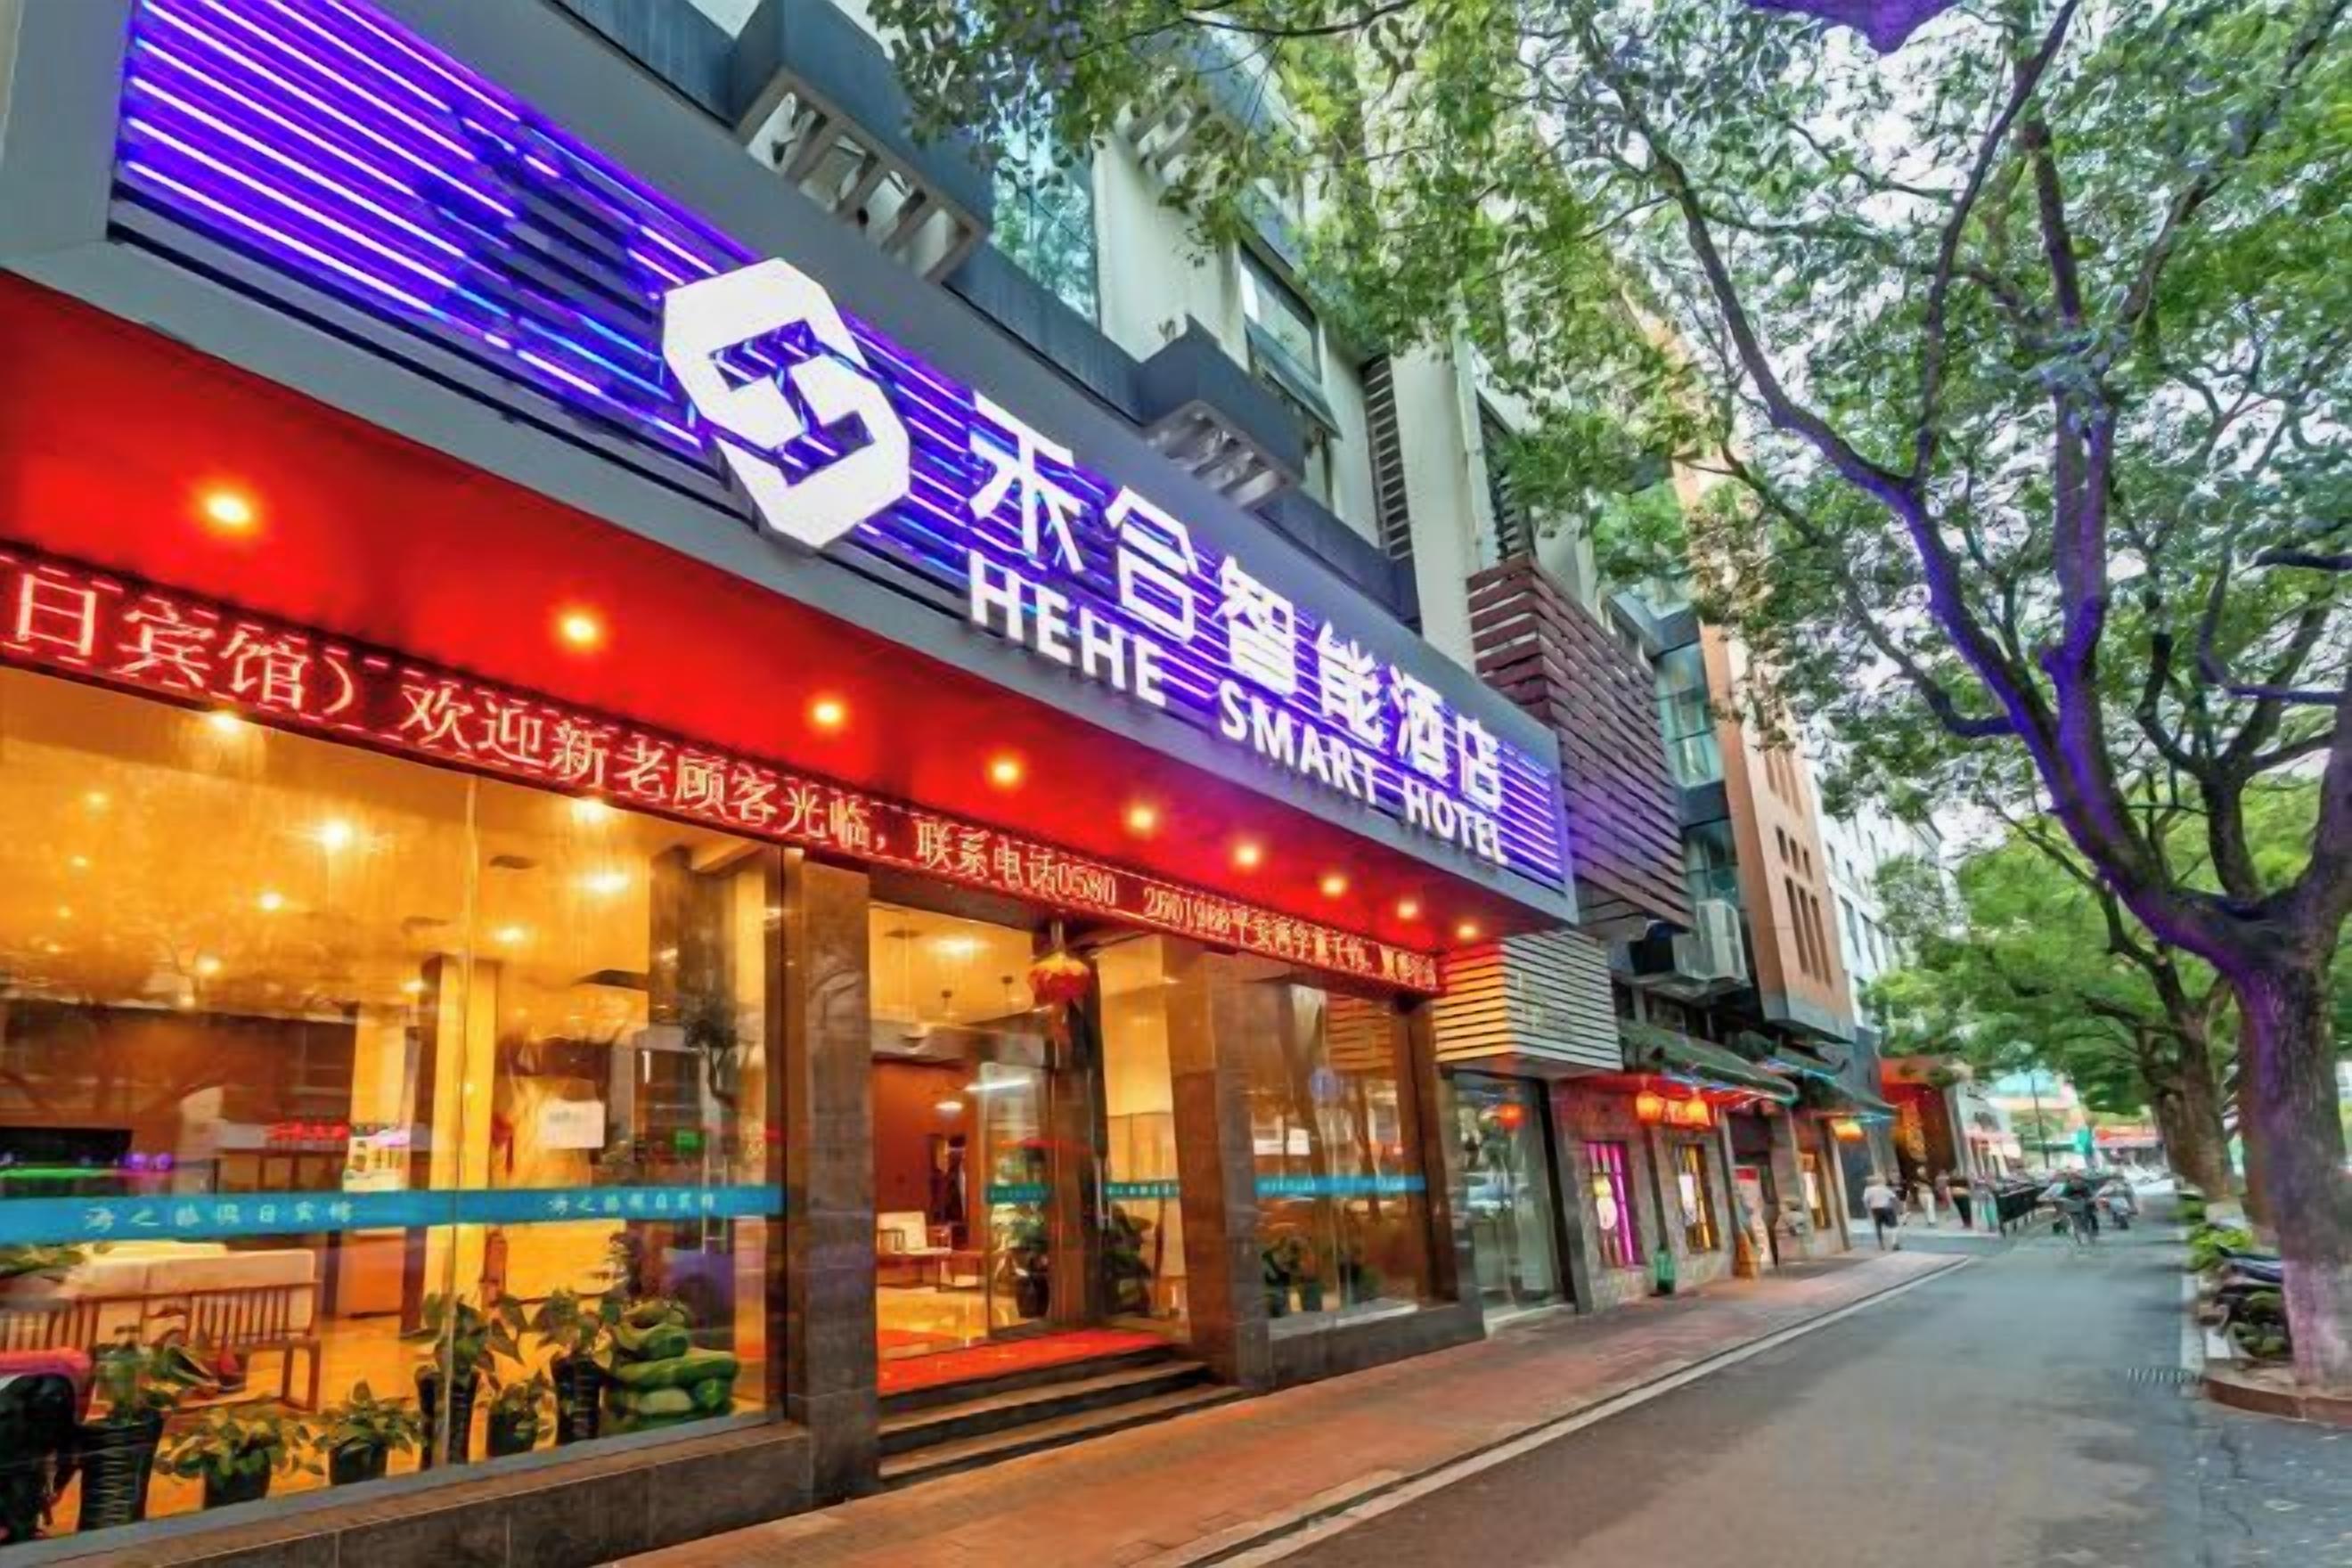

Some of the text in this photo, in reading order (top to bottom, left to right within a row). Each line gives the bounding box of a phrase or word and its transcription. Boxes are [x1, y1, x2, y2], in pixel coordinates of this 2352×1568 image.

[969, 389, 1504, 812] 禾合智能酒店
[969, 548, 1509, 866] HEHE SMART HOTEL
